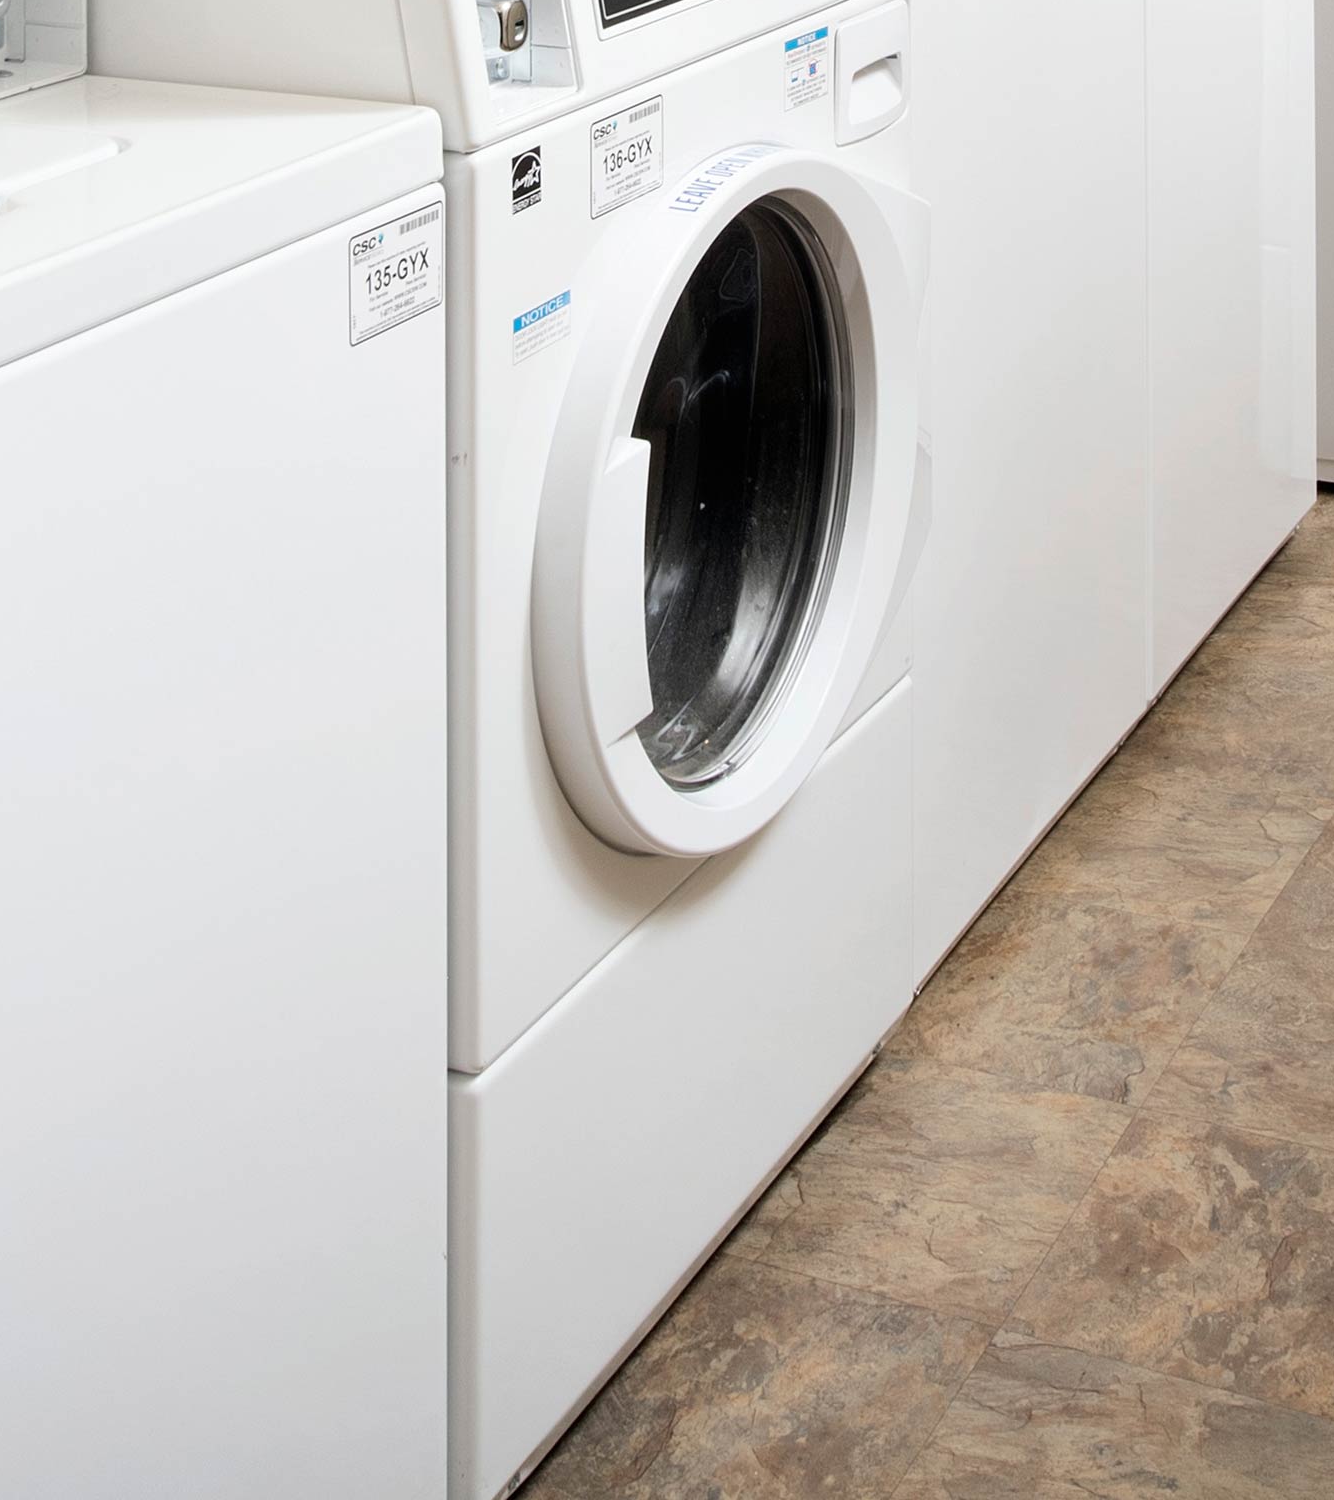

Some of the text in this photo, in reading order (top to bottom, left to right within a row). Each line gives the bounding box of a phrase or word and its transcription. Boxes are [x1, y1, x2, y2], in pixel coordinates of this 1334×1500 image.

[594, 124, 612, 140] CSC
[603, 135, 652, 175] 136-GYX
[668, 153, 755, 213] LEAVE OPEN
[353, 236, 377, 256] CSC
[366, 247, 429, 294] 135-GYX
[521, 295, 564, 328] NOTICE
